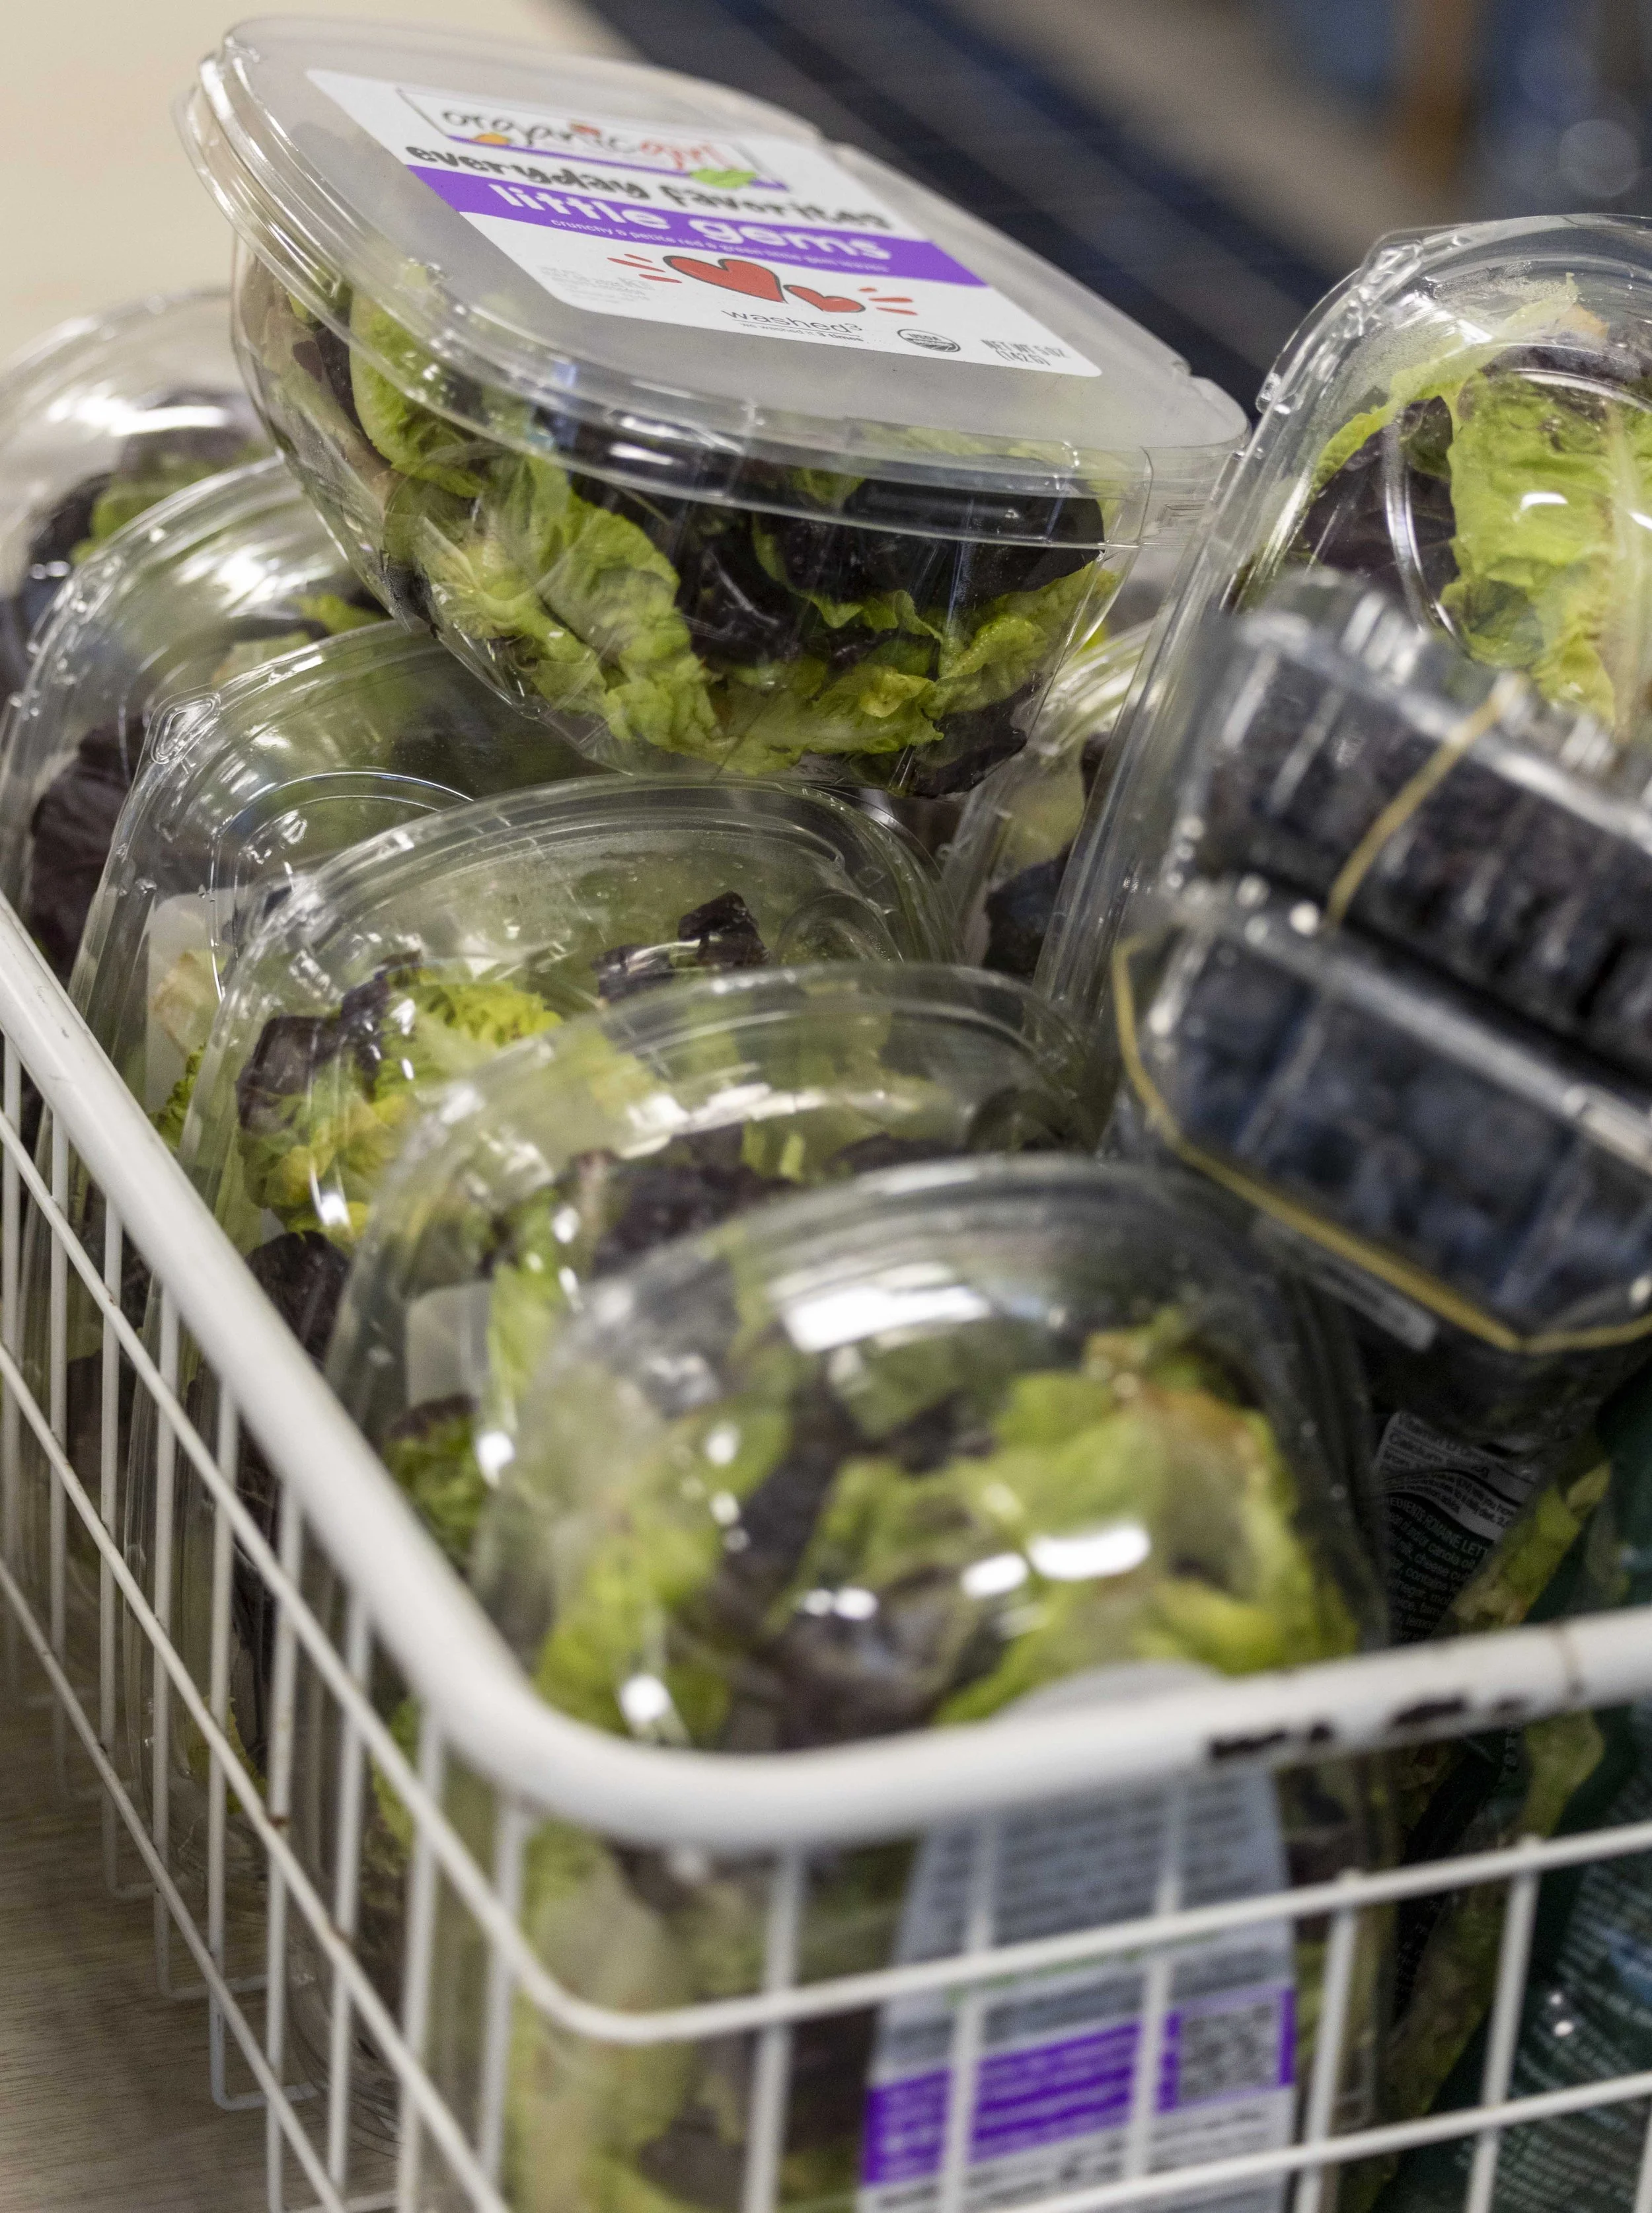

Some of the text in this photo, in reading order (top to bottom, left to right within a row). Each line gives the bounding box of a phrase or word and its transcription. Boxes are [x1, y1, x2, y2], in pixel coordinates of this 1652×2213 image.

[405, 146, 893, 229] everyday favorites
[488, 183, 891, 260] little gems
[550, 219, 613, 235] crunchy
[1424, 1514, 1462, 1548] ROMAINE
[1414, 1552, 1450, 1577] cheese
[1428, 1543, 1461, 1566] canola
